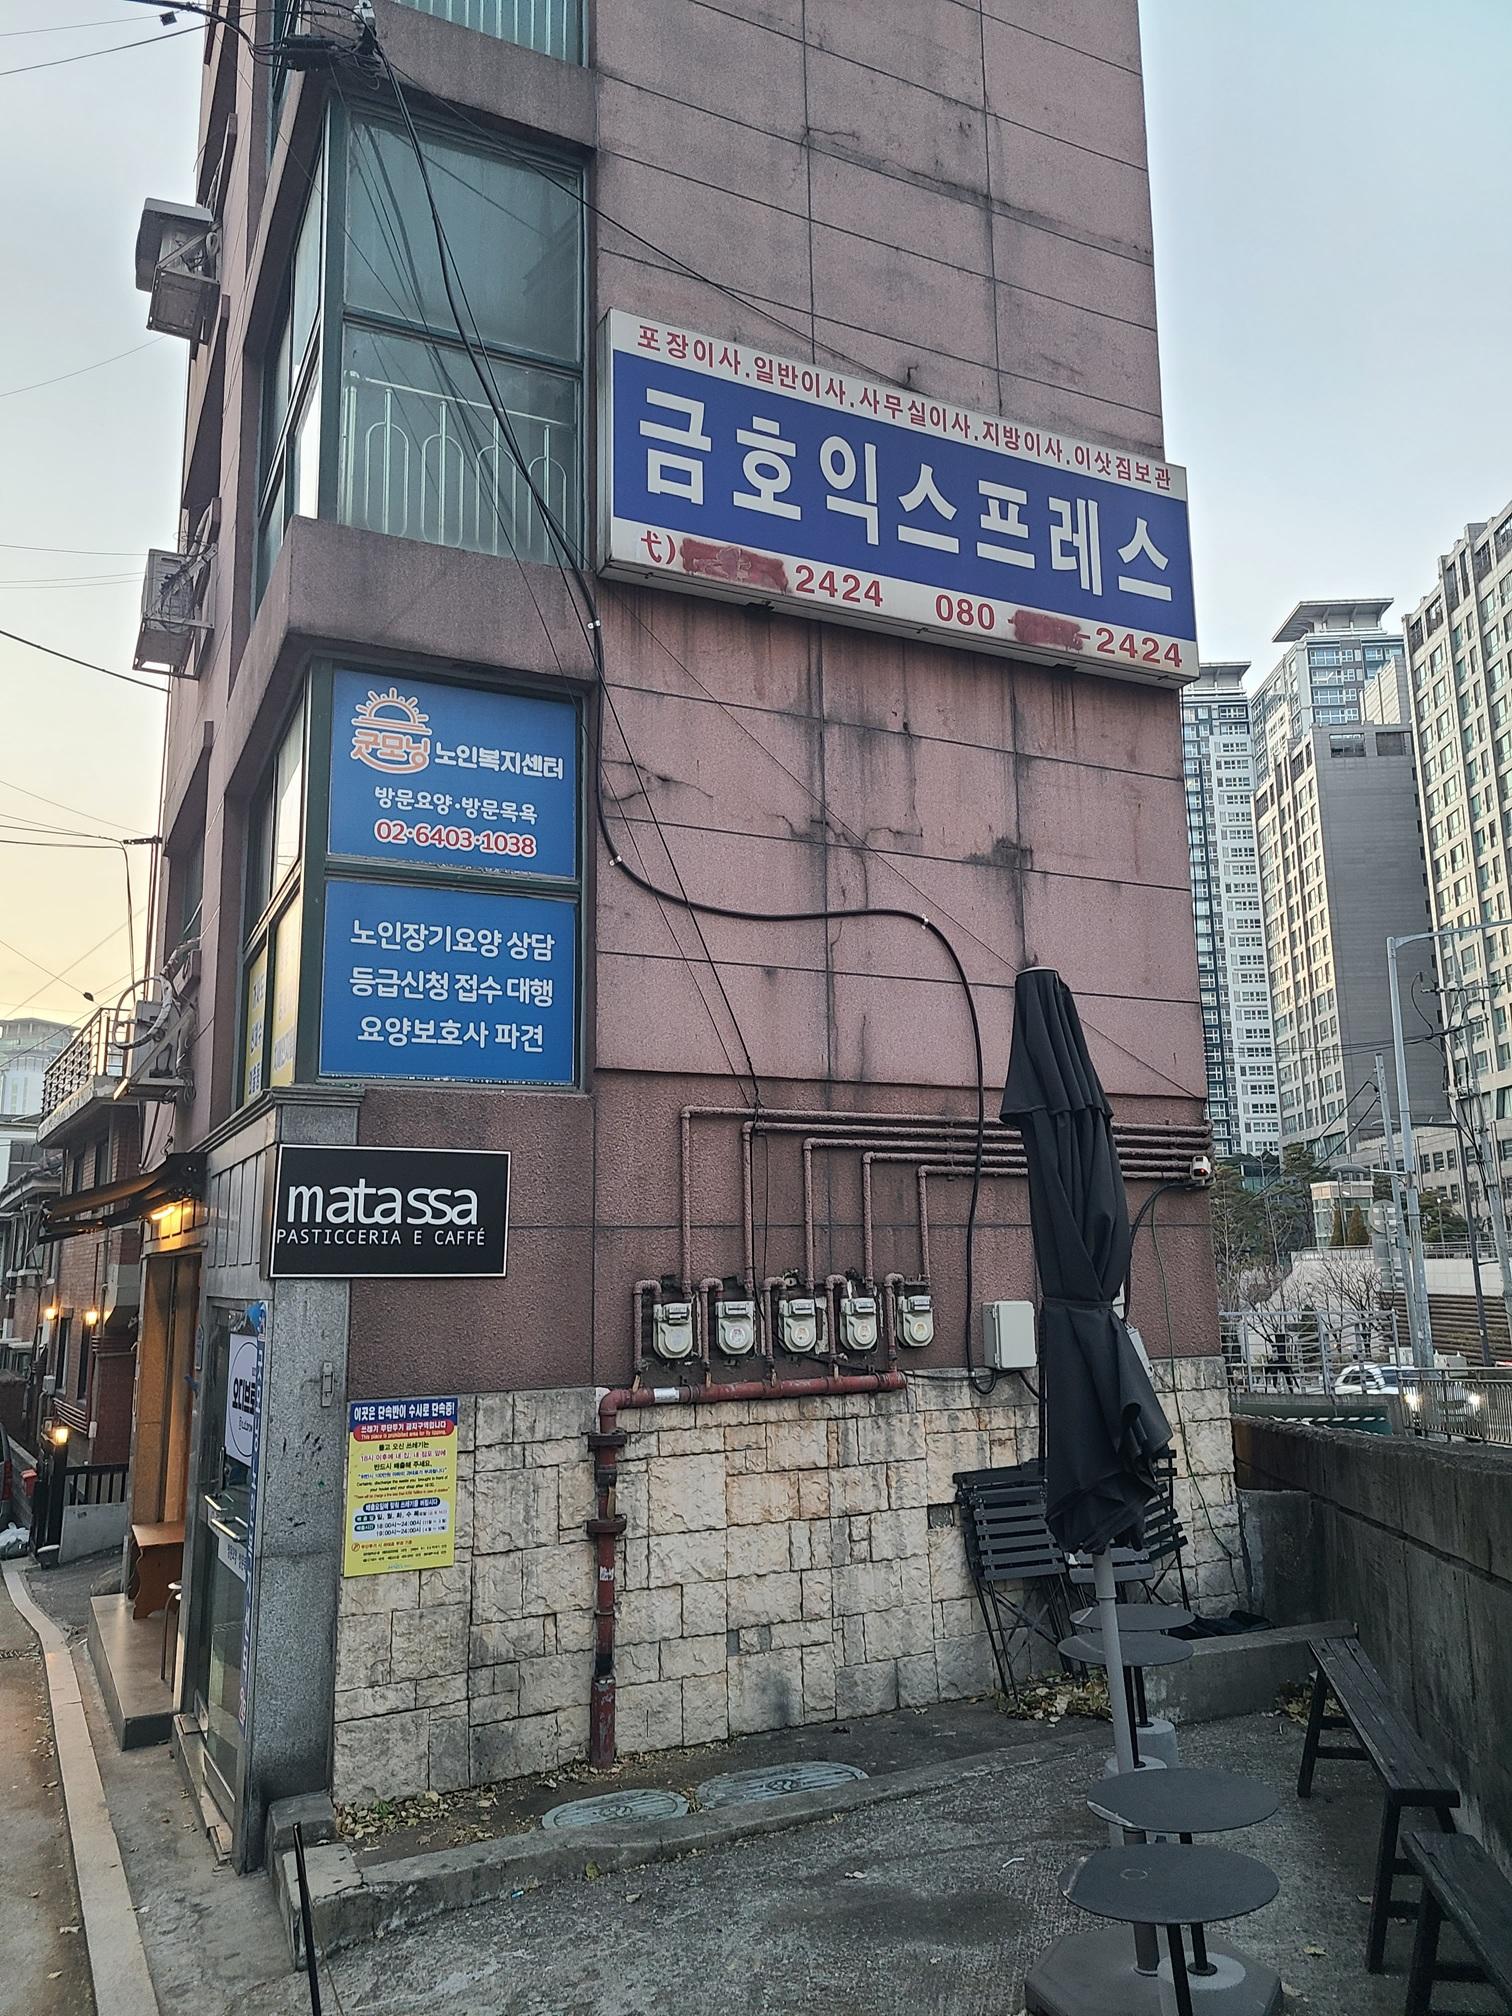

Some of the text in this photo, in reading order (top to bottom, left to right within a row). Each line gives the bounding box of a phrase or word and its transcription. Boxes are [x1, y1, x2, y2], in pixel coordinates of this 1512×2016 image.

[639, 387, 1172, 602] 금호익스프레스
[795, 564, 883, 608] 2424
[935, 593, 995, 631] 080
[351, 728, 564, 780] 굿모닝 노인복지센터
[350, 919, 556, 962] 노인장기요양 상담
[349, 967, 553, 1007] 등급신청 접수 대행
[357, 1016, 543, 1053] 요양보호사 파견
[287, 1178, 478, 1226] matassa
[276, 1227, 486, 1246] PASTICCERIA E CAFFÉ
[354, 1406, 375, 1421] 이곳은
[378, 1404, 406, 1420] 단속반이
[409, 1403, 430, 1418] 수시로
[361, 1425, 379, 1434] 쓰레기
[406, 1441, 430, 1449] 쓰레기는
